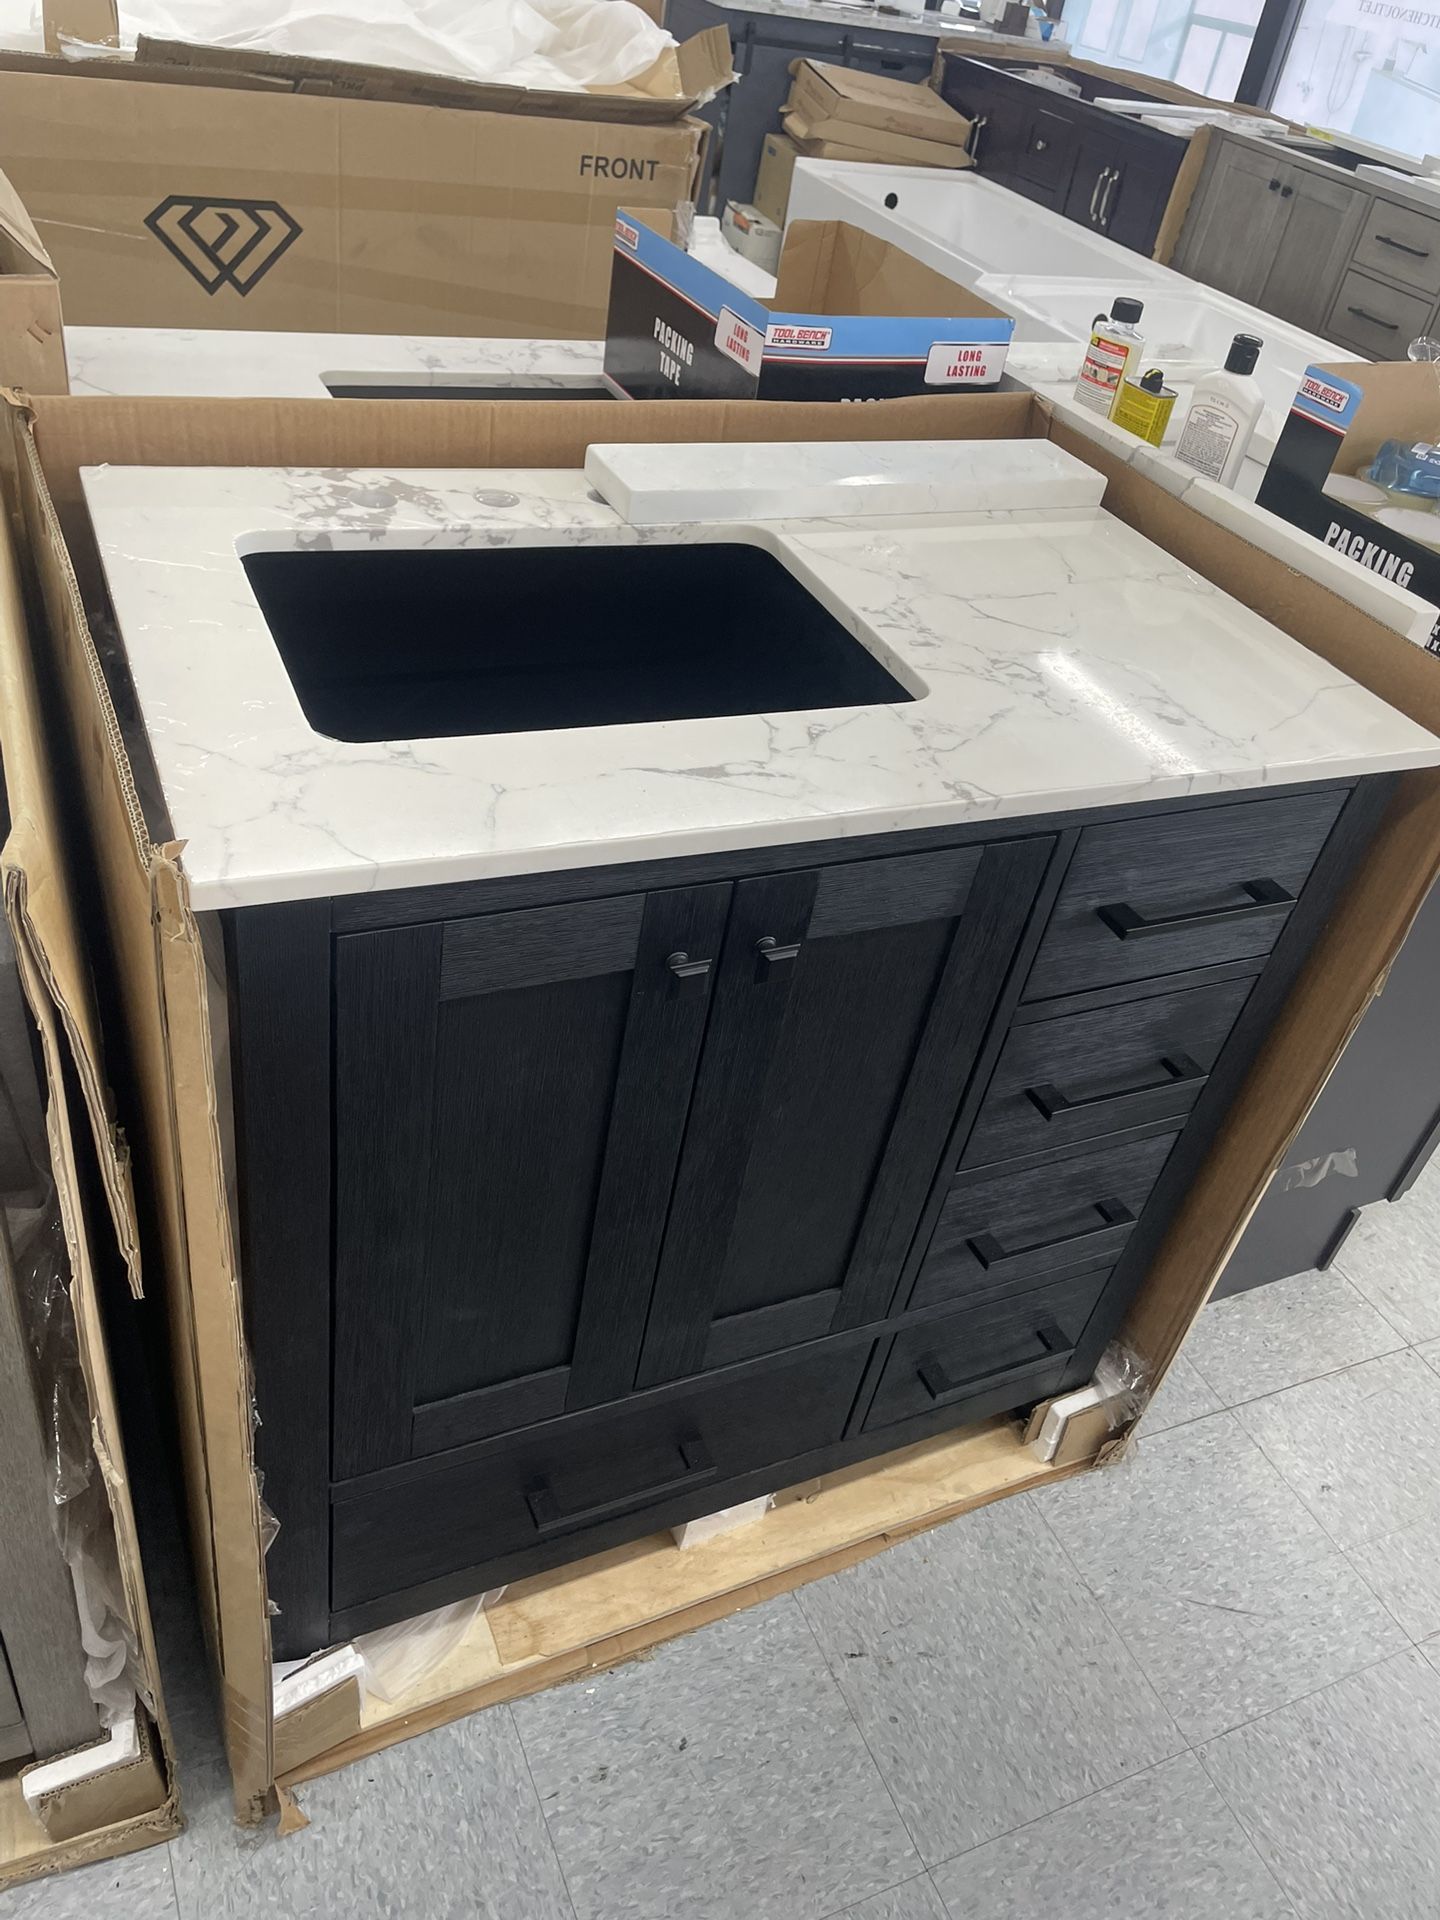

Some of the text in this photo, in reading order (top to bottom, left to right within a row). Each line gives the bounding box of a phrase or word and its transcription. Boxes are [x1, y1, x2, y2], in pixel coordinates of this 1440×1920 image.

[580, 155, 660, 181] FRONT
[653, 317, 694, 366] PACKING
[733, 323, 749, 343] LONG
[774, 328, 795, 339] TOOL
[726, 336, 750, 362] LASTING
[957, 350, 982, 362] LONG
[660, 351, 681, 386] TAPE
[946, 365, 987, 377] LASTING
[1305, 379, 1321, 393] TOOL
[1323, 521, 1415, 589] PACKING
